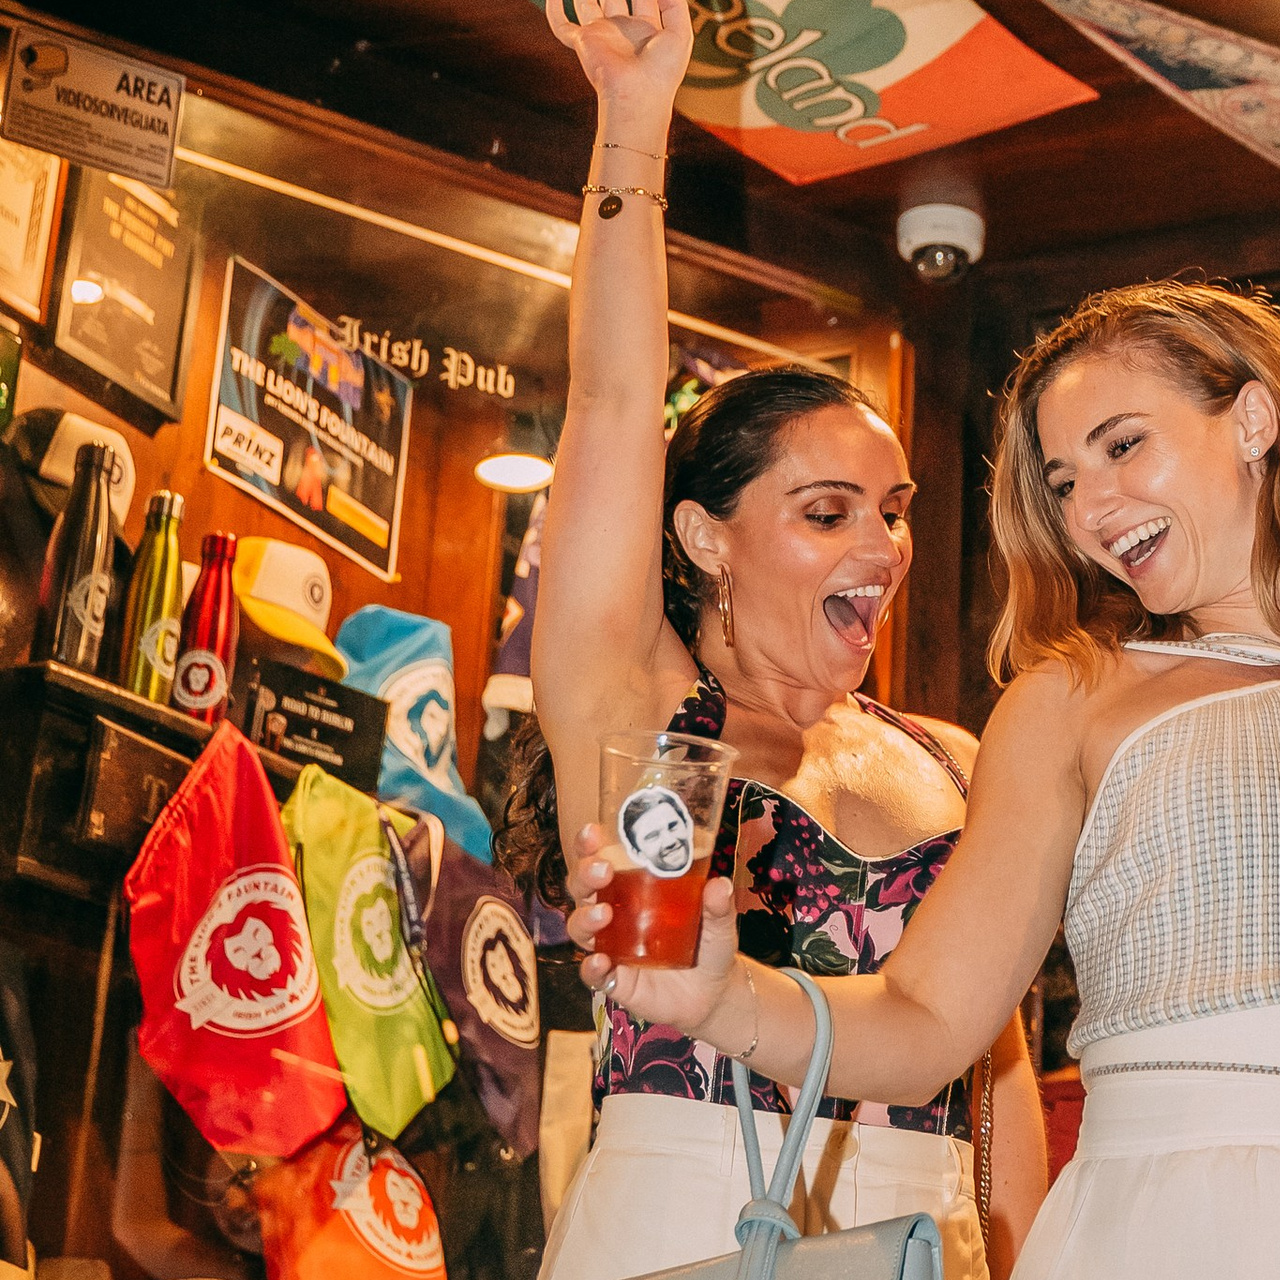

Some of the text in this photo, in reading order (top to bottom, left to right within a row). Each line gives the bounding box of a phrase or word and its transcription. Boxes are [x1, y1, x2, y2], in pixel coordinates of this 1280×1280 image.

[55, 84, 170, 137] VIDEOSORVEGLIATA
[115, 71, 173, 110] AREA
[337, 314, 516, 399] Irish Pub
